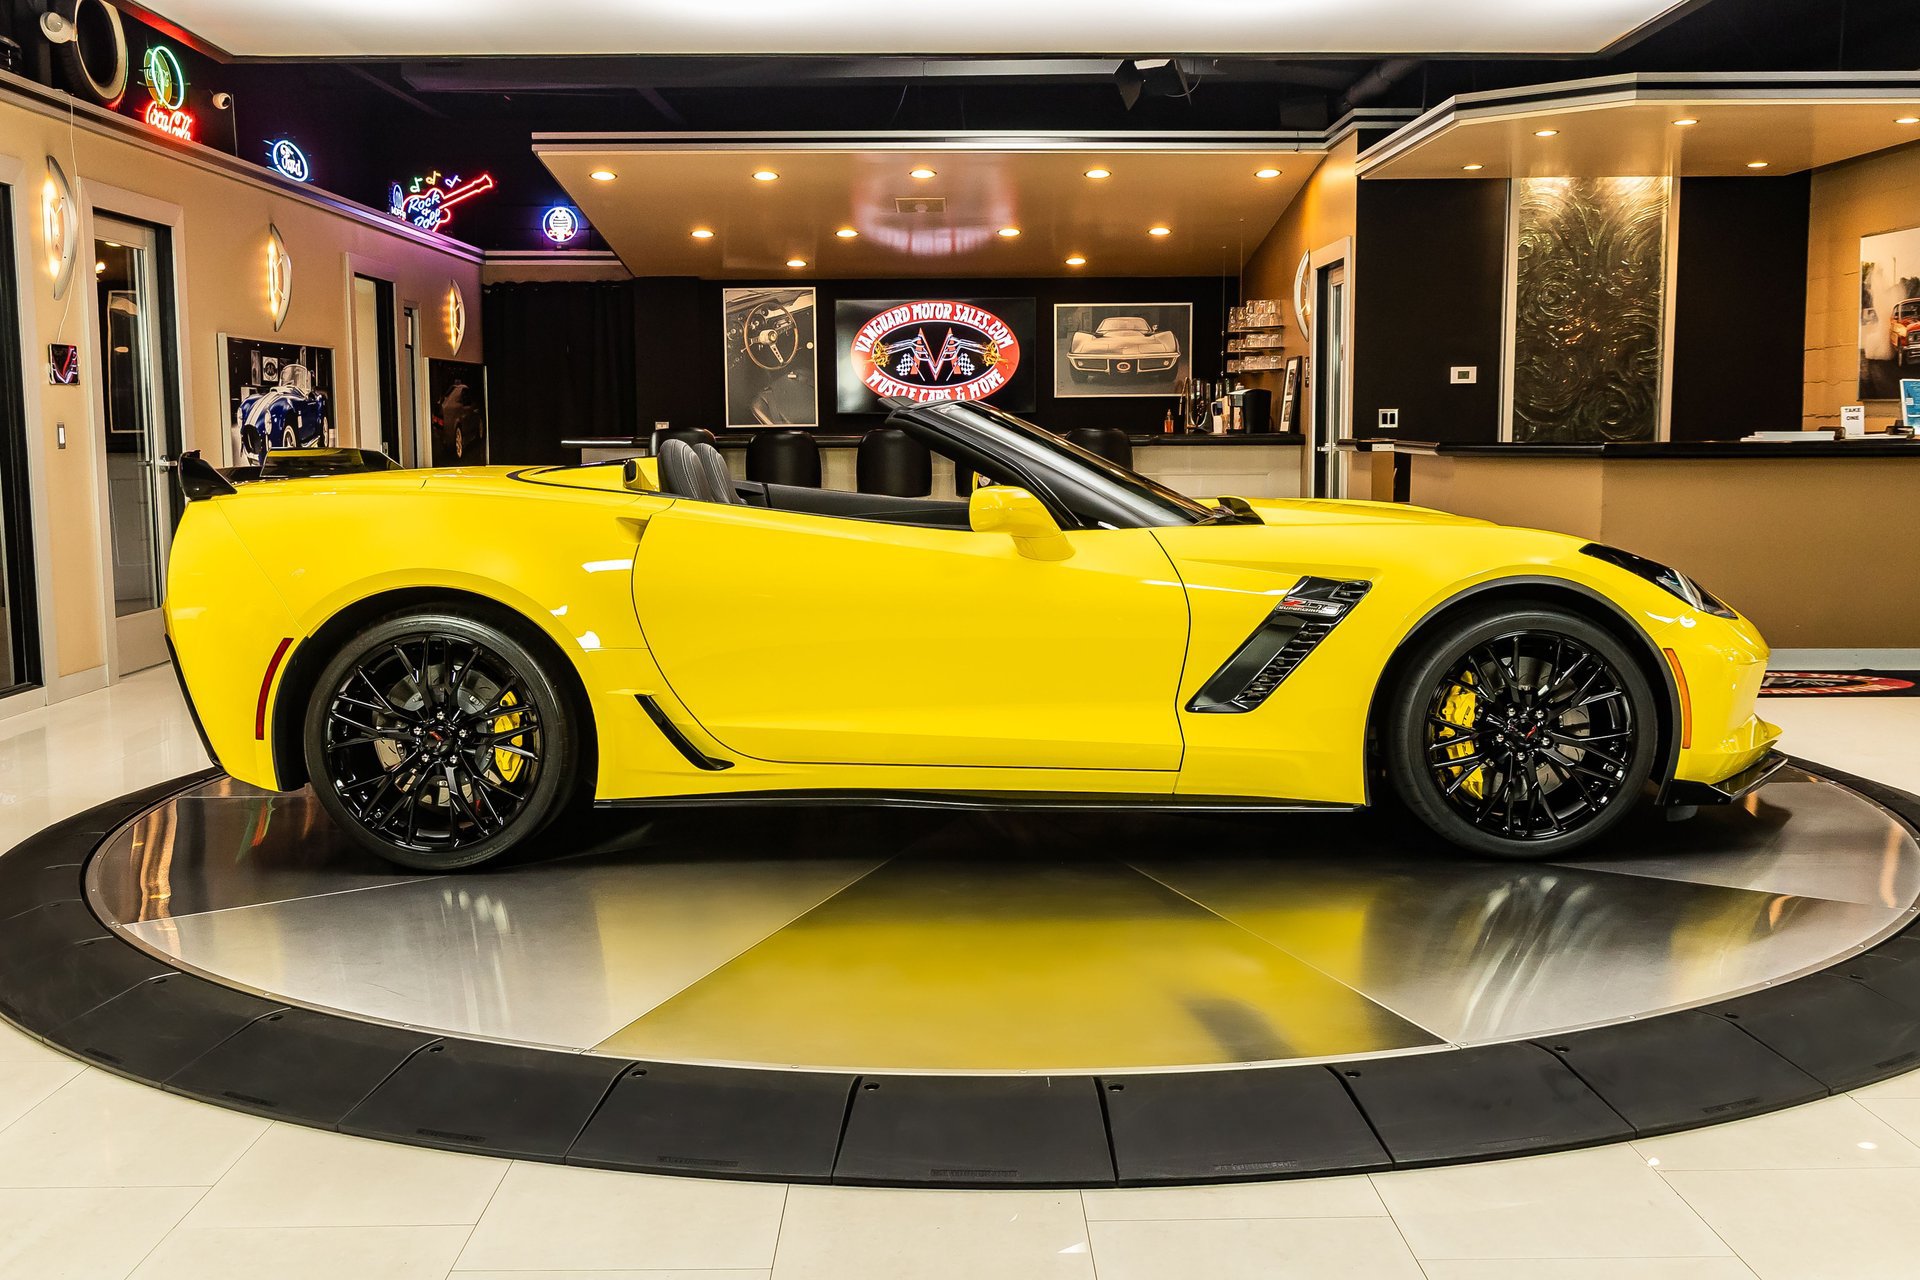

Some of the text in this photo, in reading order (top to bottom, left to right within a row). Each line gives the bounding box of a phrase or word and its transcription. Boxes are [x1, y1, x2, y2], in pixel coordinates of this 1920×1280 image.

[280, 144, 303, 177] Ford
[408, 191, 440, 213] Rock
[414, 209, 441, 228] Roll
[855, 303, 1014, 352] VANGUARD MOTOR SALES.COM
[955, 386, 965, 400] &
[968, 368, 1005, 399] MORE
